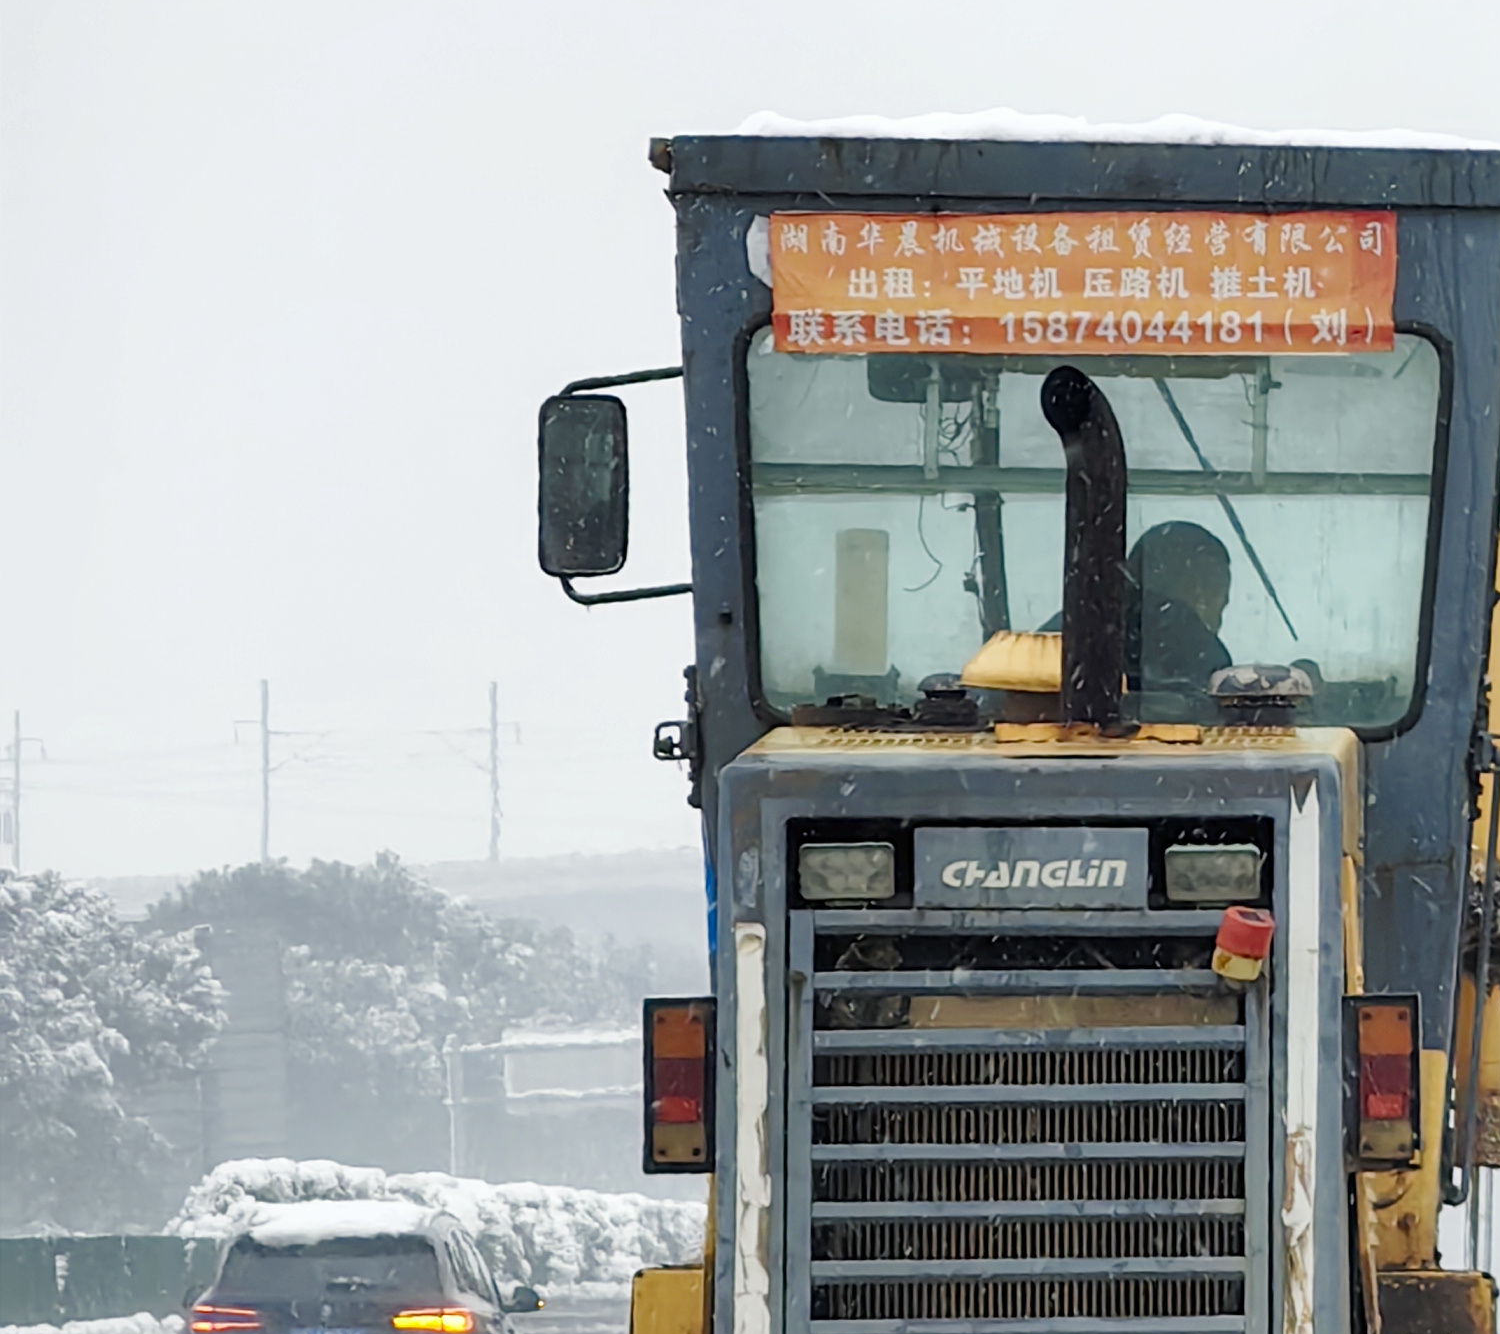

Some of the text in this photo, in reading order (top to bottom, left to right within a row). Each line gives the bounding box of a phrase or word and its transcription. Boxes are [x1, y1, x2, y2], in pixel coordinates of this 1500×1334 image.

[1082, 267, 1190, 299] 压路机
[1210, 267, 1317, 299] 推土机
